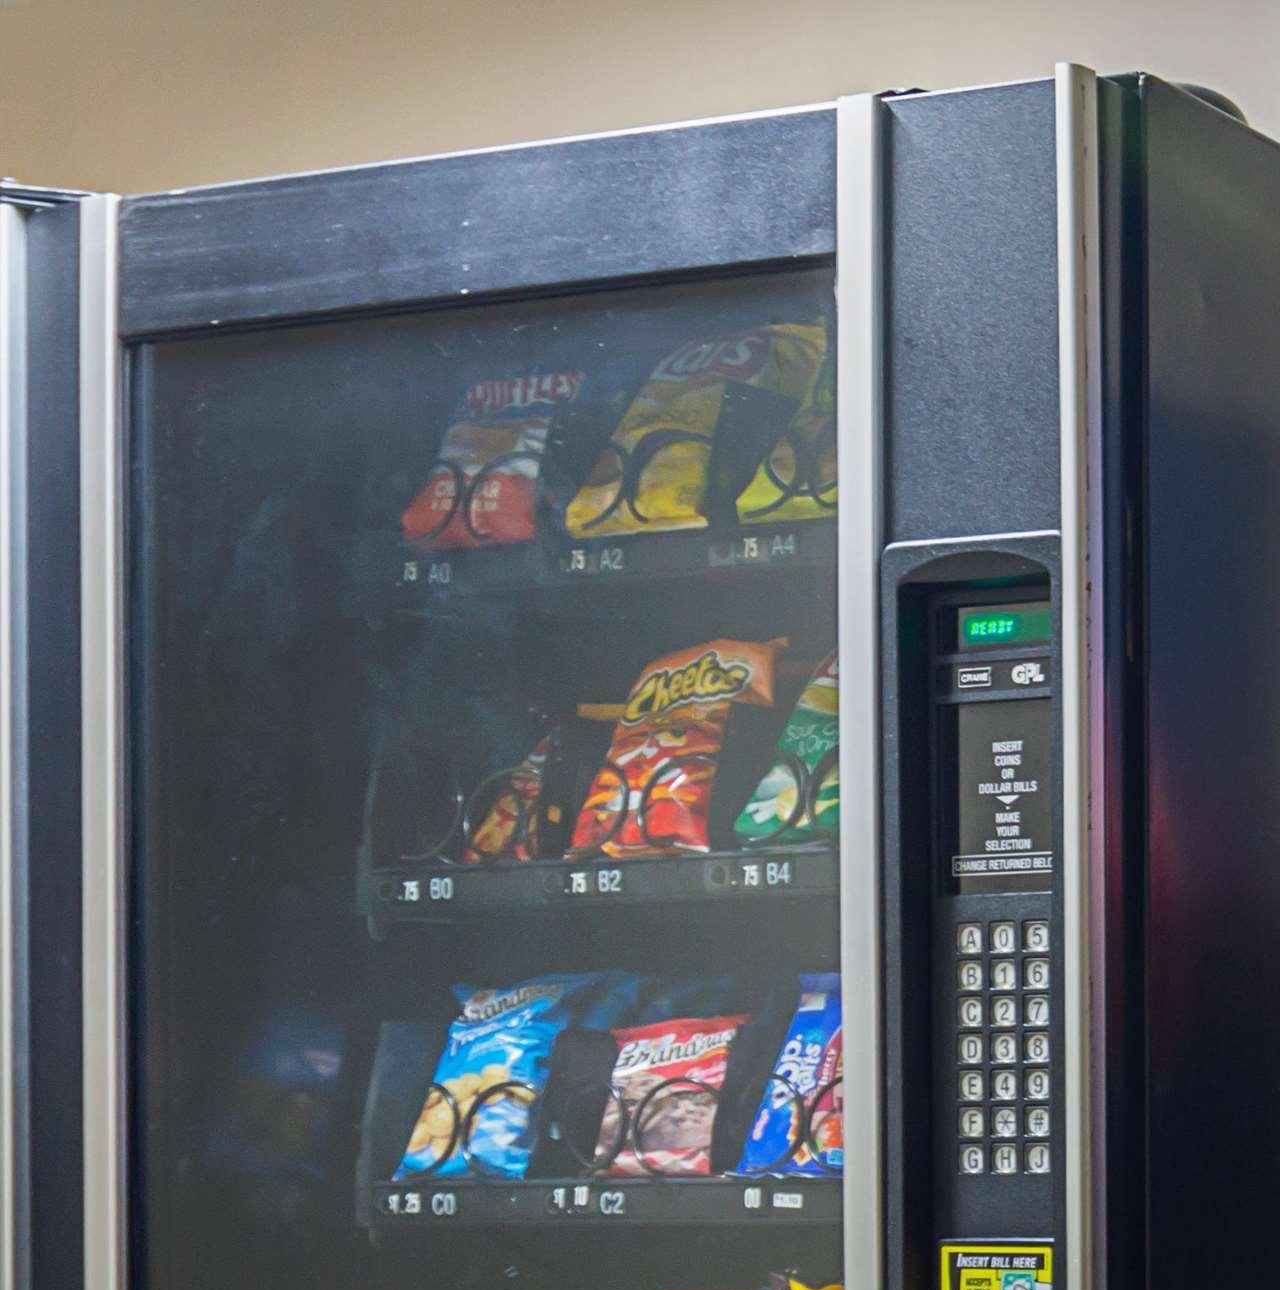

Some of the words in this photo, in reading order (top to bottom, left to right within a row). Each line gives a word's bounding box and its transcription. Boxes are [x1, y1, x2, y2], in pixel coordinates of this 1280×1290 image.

[600, 548, 623, 570] A2
[622, 650, 752, 725] Cheetos
[992, 741, 1023, 753] INSERT
[994, 755, 1021, 767] COINS
[1001, 768, 1015, 779] OR
[979, 782, 1012, 794] DOLLAR
[1013, 780, 1038, 792] BILLS
[995, 812, 1020, 823] MAKE
[996, 825, 1020, 837] YOUR
[985, 839, 1032, 851] SELECTION
[767, 862, 790, 884] B4
[955, 860, 987, 872] CHANGE
[988, 858, 1031, 870] RETURNED
[598, 870, 622, 892] B2
[966, 930, 976, 947] A
[1033, 927, 1042, 945] 5
[967, 967, 977, 985] B
[1000, 967, 1008, 985] 1
[1033, 964, 1042, 982] 6
[966, 1001, 977, 1020] C
[1000, 1002, 1009, 1020] 2
[1033, 1001, 1043, 1020] 7
[967, 1040, 977, 1058] D
[1000, 1039, 1009, 1057] 3
[1033, 1038, 1043, 1056] 8
[968, 1076, 977, 1095] E
[1000, 1076, 1009, 1094] 4
[1033, 1074, 1043, 1093] 9
[968, 1113, 977, 1132] F
[1033, 1113, 1044, 1131] #
[967, 1150, 978, 1170] G
[1000, 1149, 1011, 1168] H
[1034, 1148, 1044, 1168] J
[600, 1192, 625, 1214] C2
[957, 1253, 989, 1267] INSERT
[991, 1257, 1011, 1268] BILL
[1012, 1257, 1037, 1268] HERE
